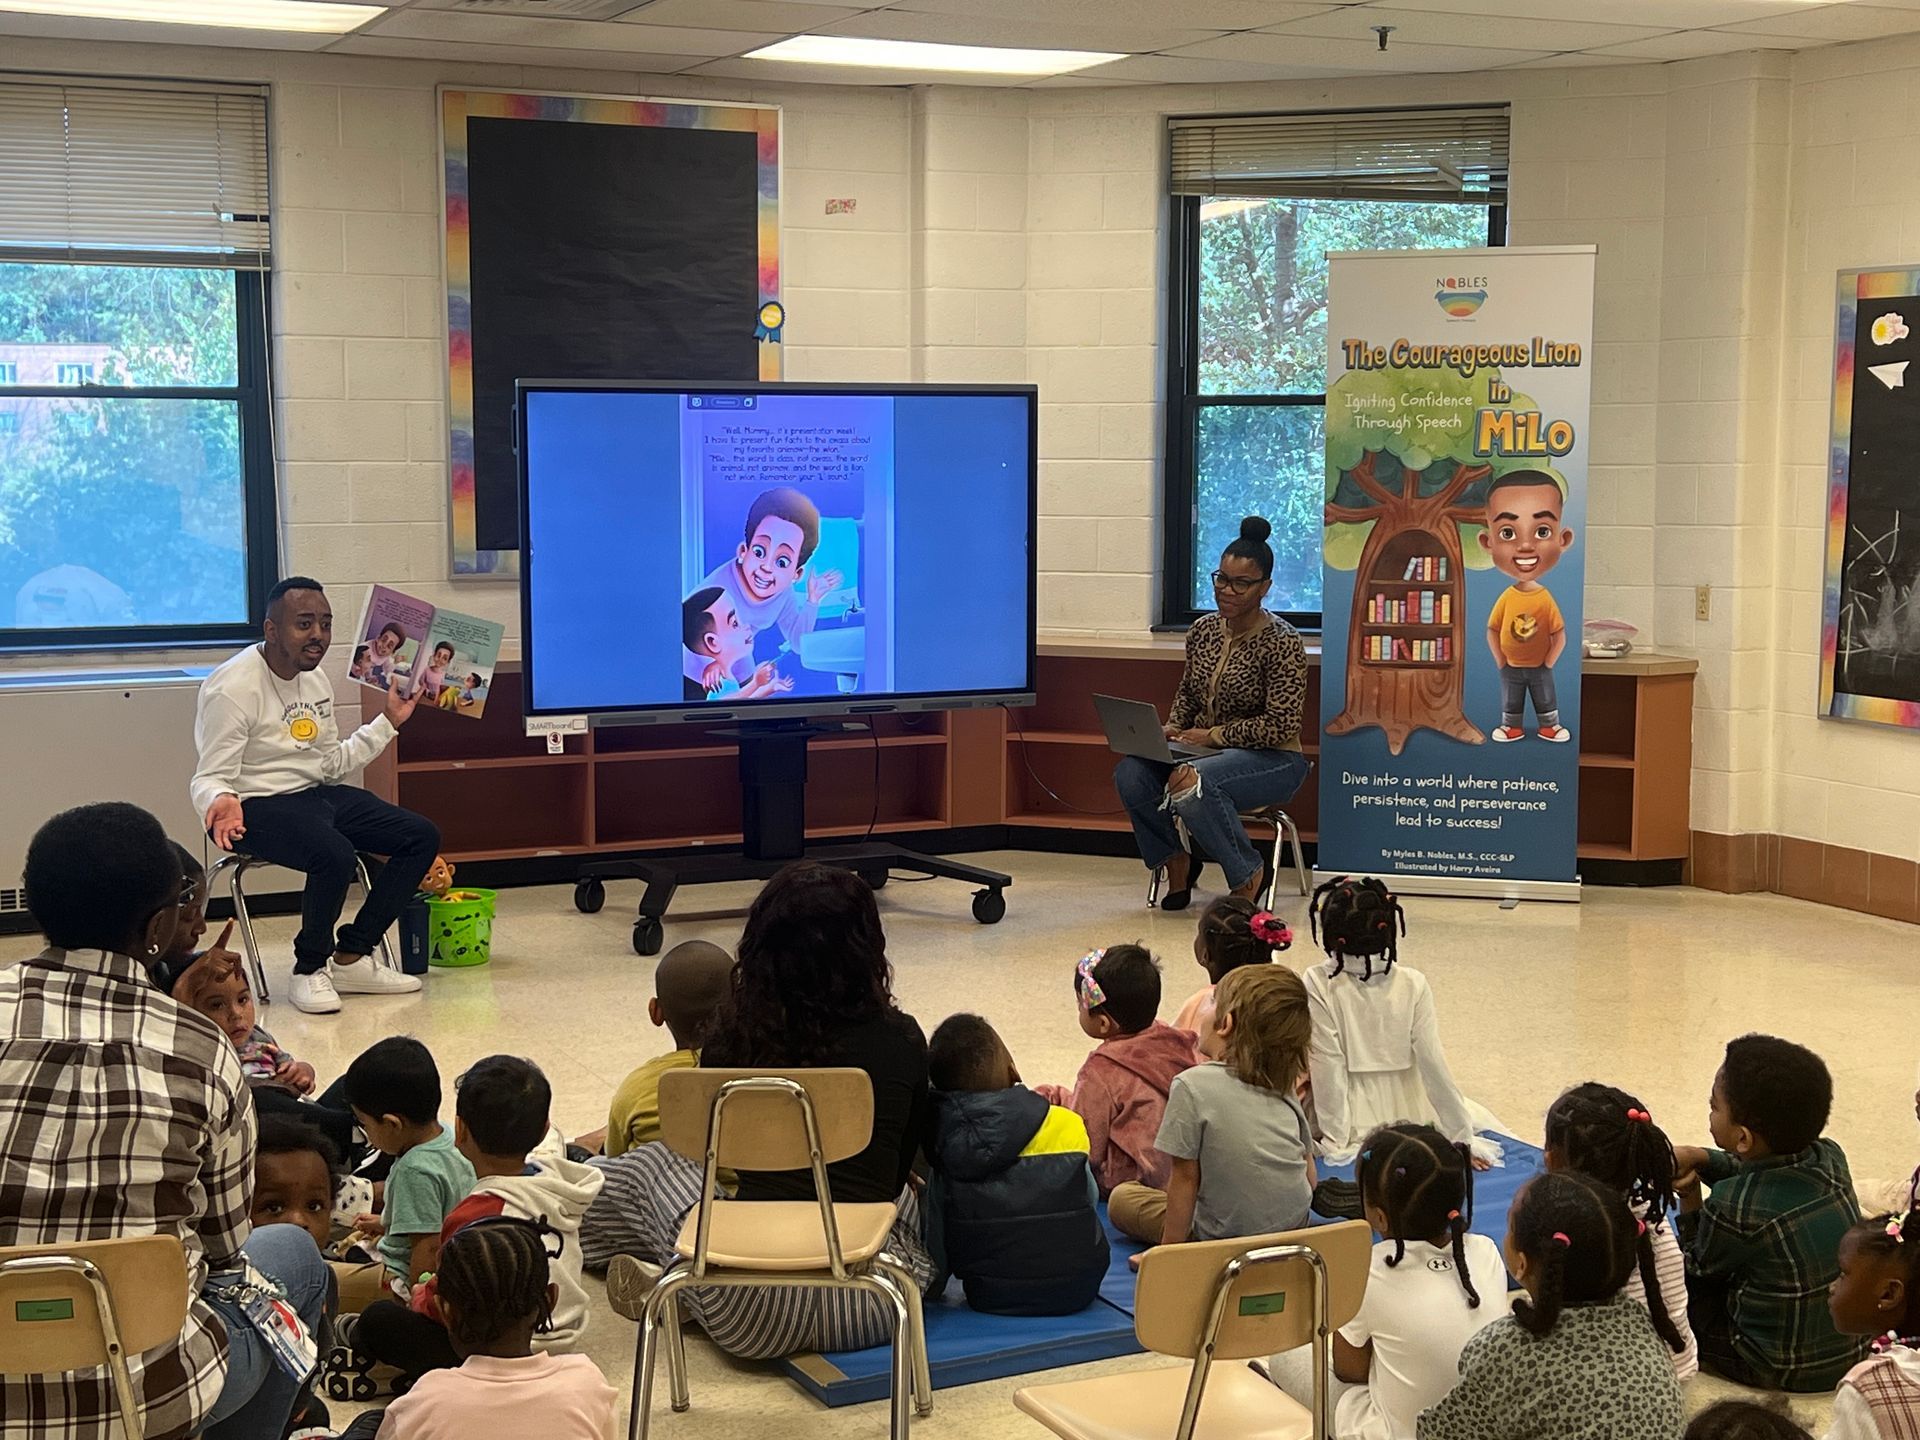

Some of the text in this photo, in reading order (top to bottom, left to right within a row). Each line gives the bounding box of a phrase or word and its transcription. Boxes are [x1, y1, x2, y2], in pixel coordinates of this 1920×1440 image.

[1436, 276, 1488, 289] NOBLES
[1342, 336, 1582, 378] The Courageous Lion
[1489, 376, 1512, 404] in
[1344, 391, 1473, 413] Igniting Confidence
[1354, 413, 1462, 435] Through Speech
[741, 436, 768, 445] present
[770, 436, 783, 444] fun
[1342, 771, 1560, 794] Dive into a world where patience,
[1353, 792, 1547, 813] persistence, and perseverance
[1395, 812, 1502, 829] lead to success!
[1381, 849, 1392, 859] By
[1393, 850, 1416, 859] Myles
[1427, 851, 1456, 860] Nobles,
[1479, 853, 1515, 862] CCC-SLP
[1395, 862, 1437, 871] Illustrated
[1439, 863, 1448, 873] by
[1450, 864, 1473, 874] Harry
